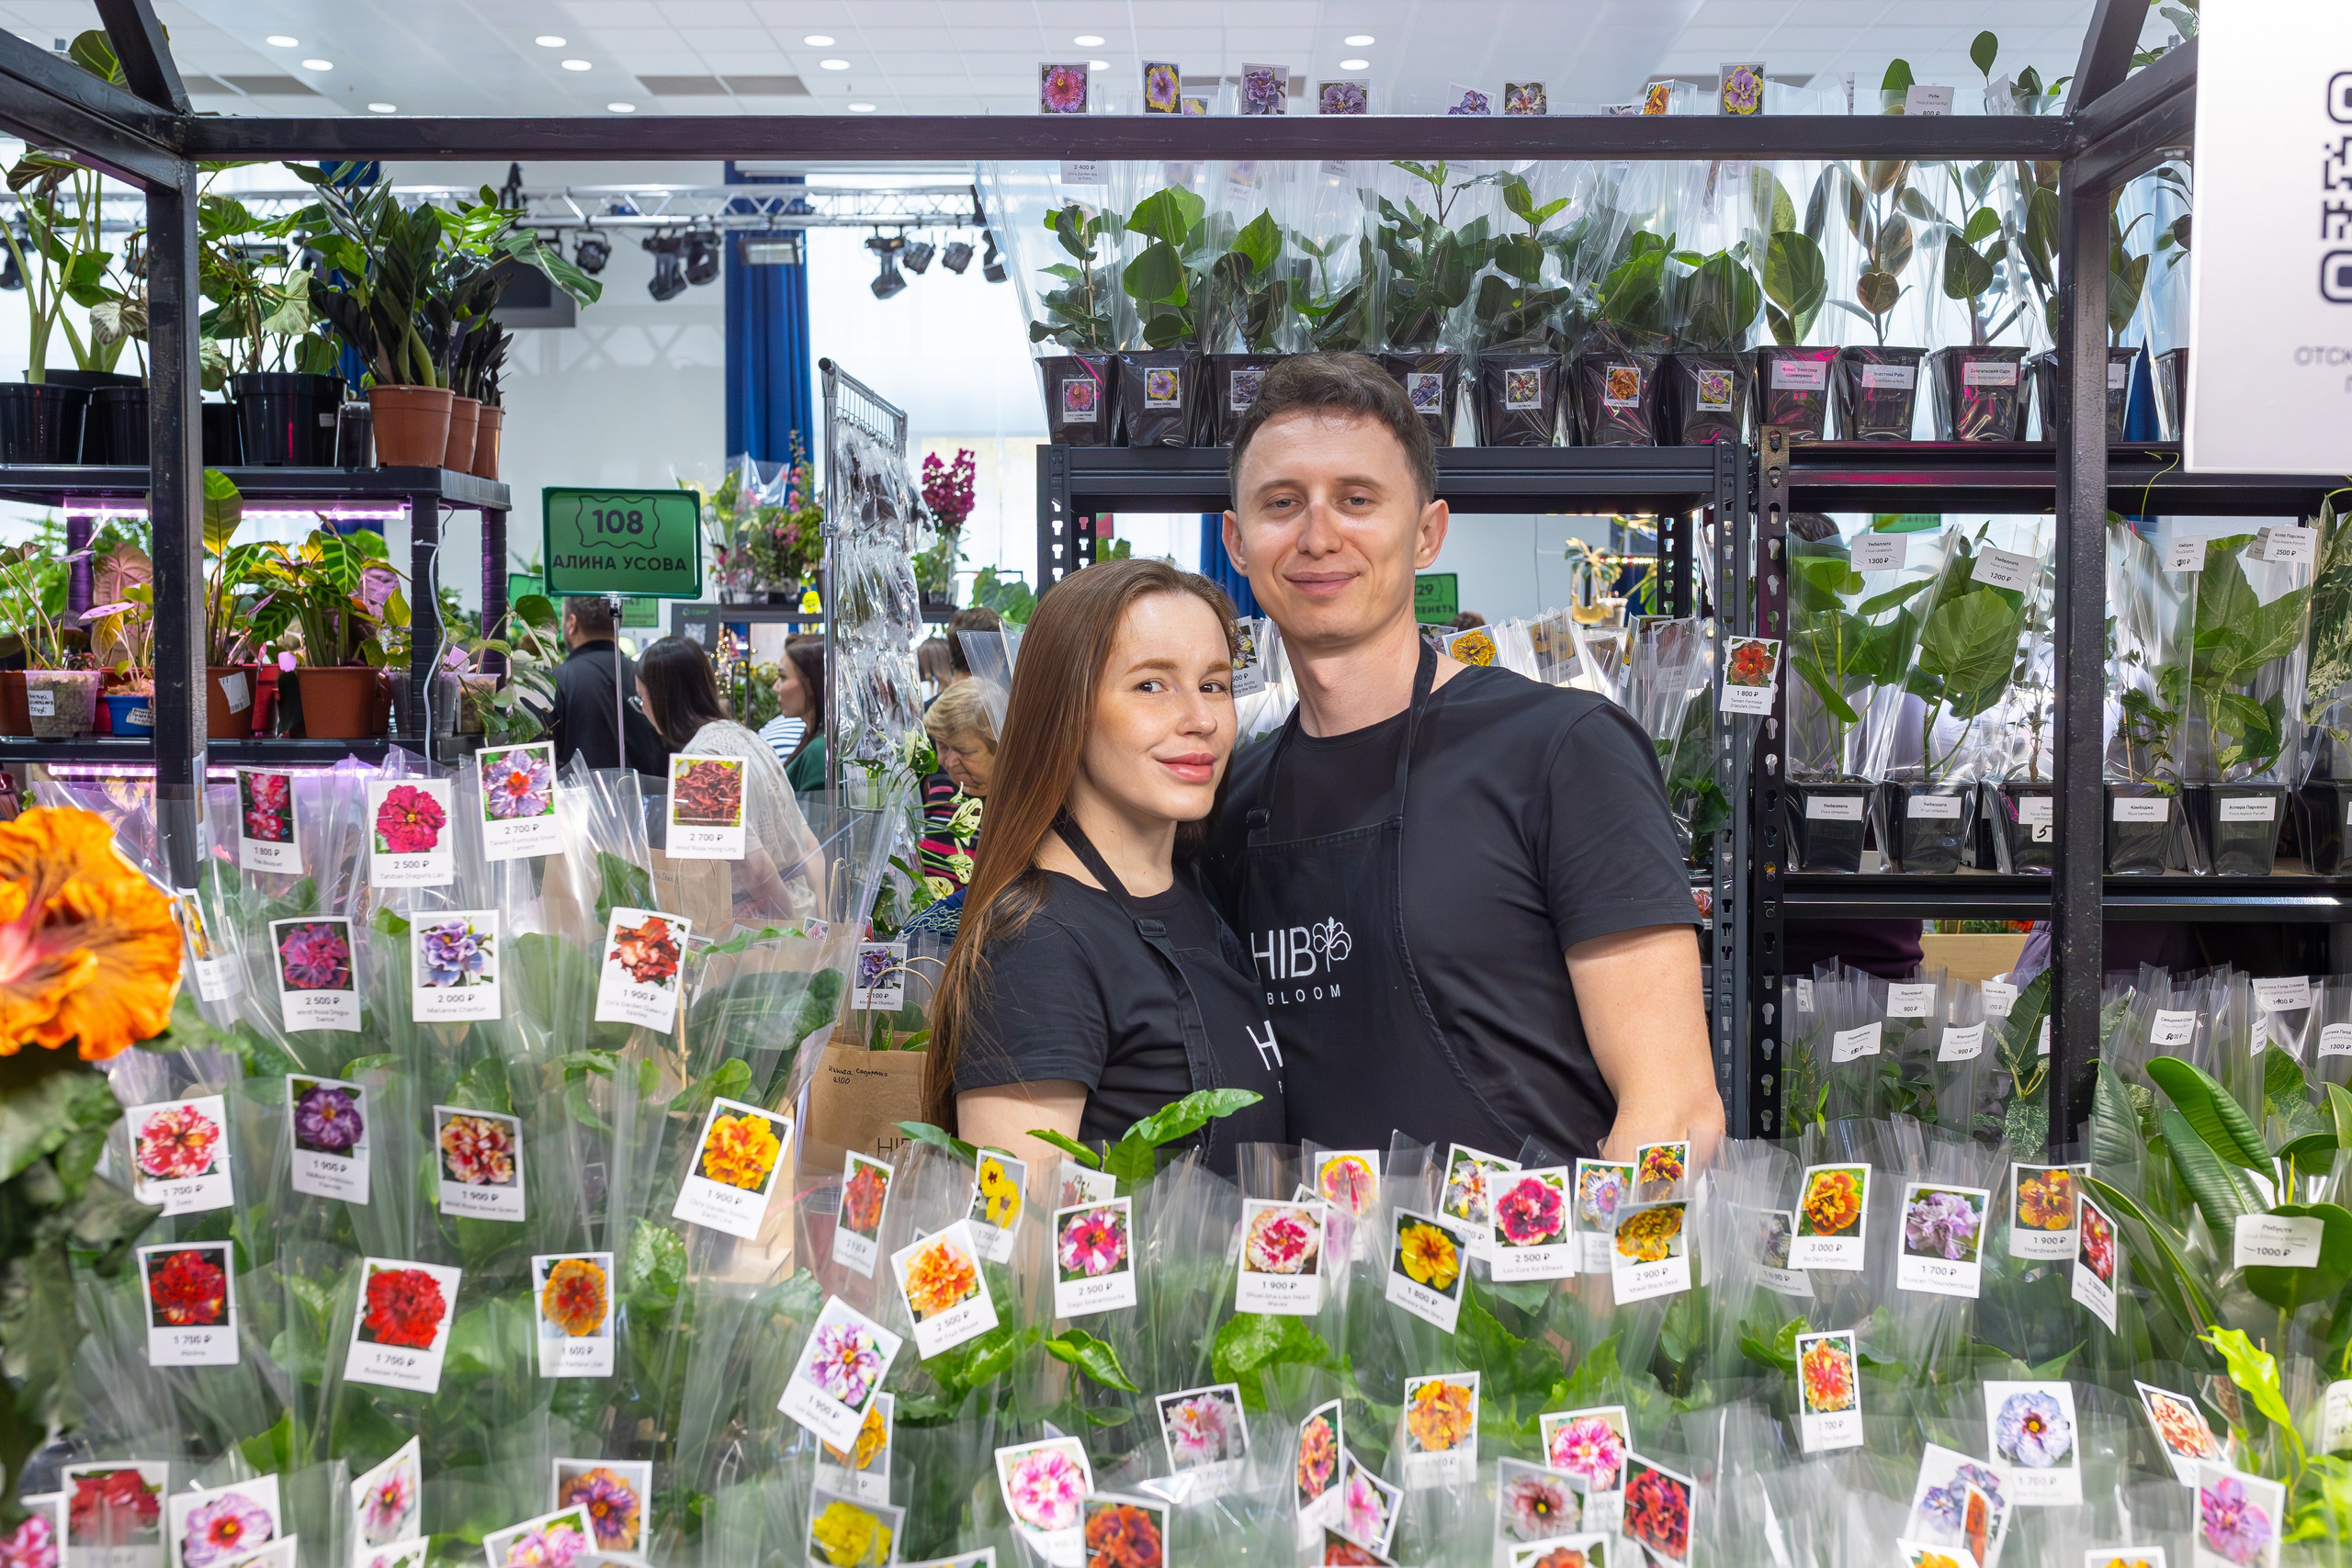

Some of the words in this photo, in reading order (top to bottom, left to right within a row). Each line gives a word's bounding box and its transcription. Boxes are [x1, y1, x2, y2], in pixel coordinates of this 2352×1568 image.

[592, 509, 644, 535] 108
[552, 554, 616, 570] АЛИНА
[622, 556, 687, 571] УСОВА
[1990, 571, 2006, 581] 1200
[505, 827, 511, 835] 2
[514, 825, 531, 834] 700
[690, 833, 695, 841] 2
[697, 833, 715, 841] 700
[717, 833, 724, 841] ₽
[394, 861, 400, 869] 2
[402, 861, 421, 869] 500
[423, 860, 430, 868] ₽
[438, 995, 444, 1003] 2
[446, 995, 465, 1003] 000
[631, 990, 649, 1000] 900
[1266, 983, 1341, 1006] BLOOM
[305, 997, 311, 1006] 2
[313, 997, 332, 1006] 500
[334, 997, 341, 1005] ₽
[1246, 1020, 1283, 1071] H
[716, 1190, 733, 1203] 900
[735, 1197, 743, 1205] ₽
[2041, 1236, 2058, 1245] 900
[2060, 1236, 2067, 1245] ₽
[1810, 1244, 1816, 1252] 3
[1818, 1244, 1834, 1252] 000
[1836, 1244, 1842, 1252] ₽
[2256, 1247, 2281, 1257] 1000
[2283, 1248, 2291, 1257] ₽
[1514, 1254, 1521, 1263] 2
[1523, 1253, 1542, 1262] 500
[1544, 1253, 1551, 1261] ₽
[1635, 1272, 1642, 1281] 2
[1644, 1270, 1660, 1280] 900
[1662, 1268, 1668, 1276] ₽
[1929, 1267, 1948, 1276] 700
[1950, 1269, 1958, 1277] ₽
[1078, 1286, 1084, 1296] 2
[1087, 1283, 1103, 1295] 500
[1106, 1281, 1113, 1291] ₽
[1270, 1281, 1288, 1290] 900
[1290, 1281, 1297, 1290] ₽
[1430, 1299, 1439, 1307] ₽
[936, 1323, 942, 1332] 2
[944, 1314, 961, 1327] 500
[964, 1309, 970, 1318] ₽
[406, 1357, 417, 1367] ₽
[832, 1411, 841, 1419] ₽
